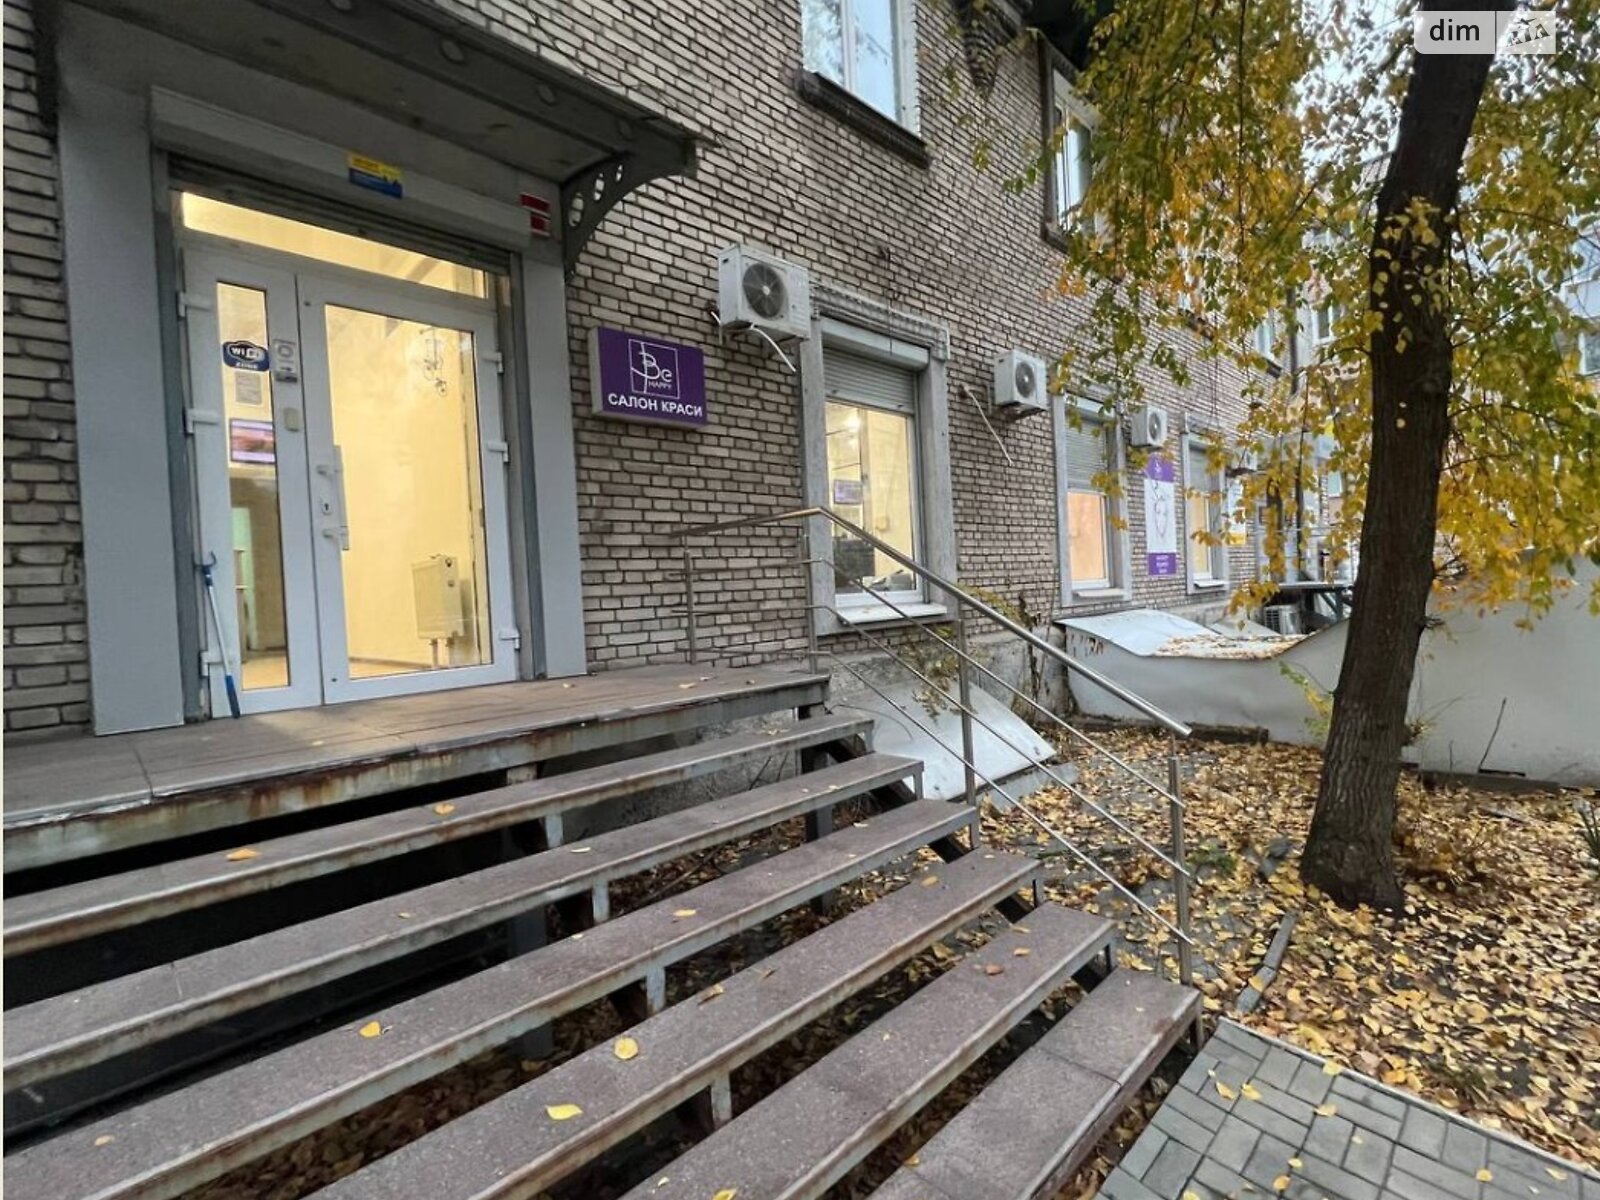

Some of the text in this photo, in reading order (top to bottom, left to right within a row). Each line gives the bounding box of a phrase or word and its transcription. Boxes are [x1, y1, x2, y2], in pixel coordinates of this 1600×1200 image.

[633, 342, 672, 391] Be
[608, 393, 703, 417] САЛОН КРАСИ
